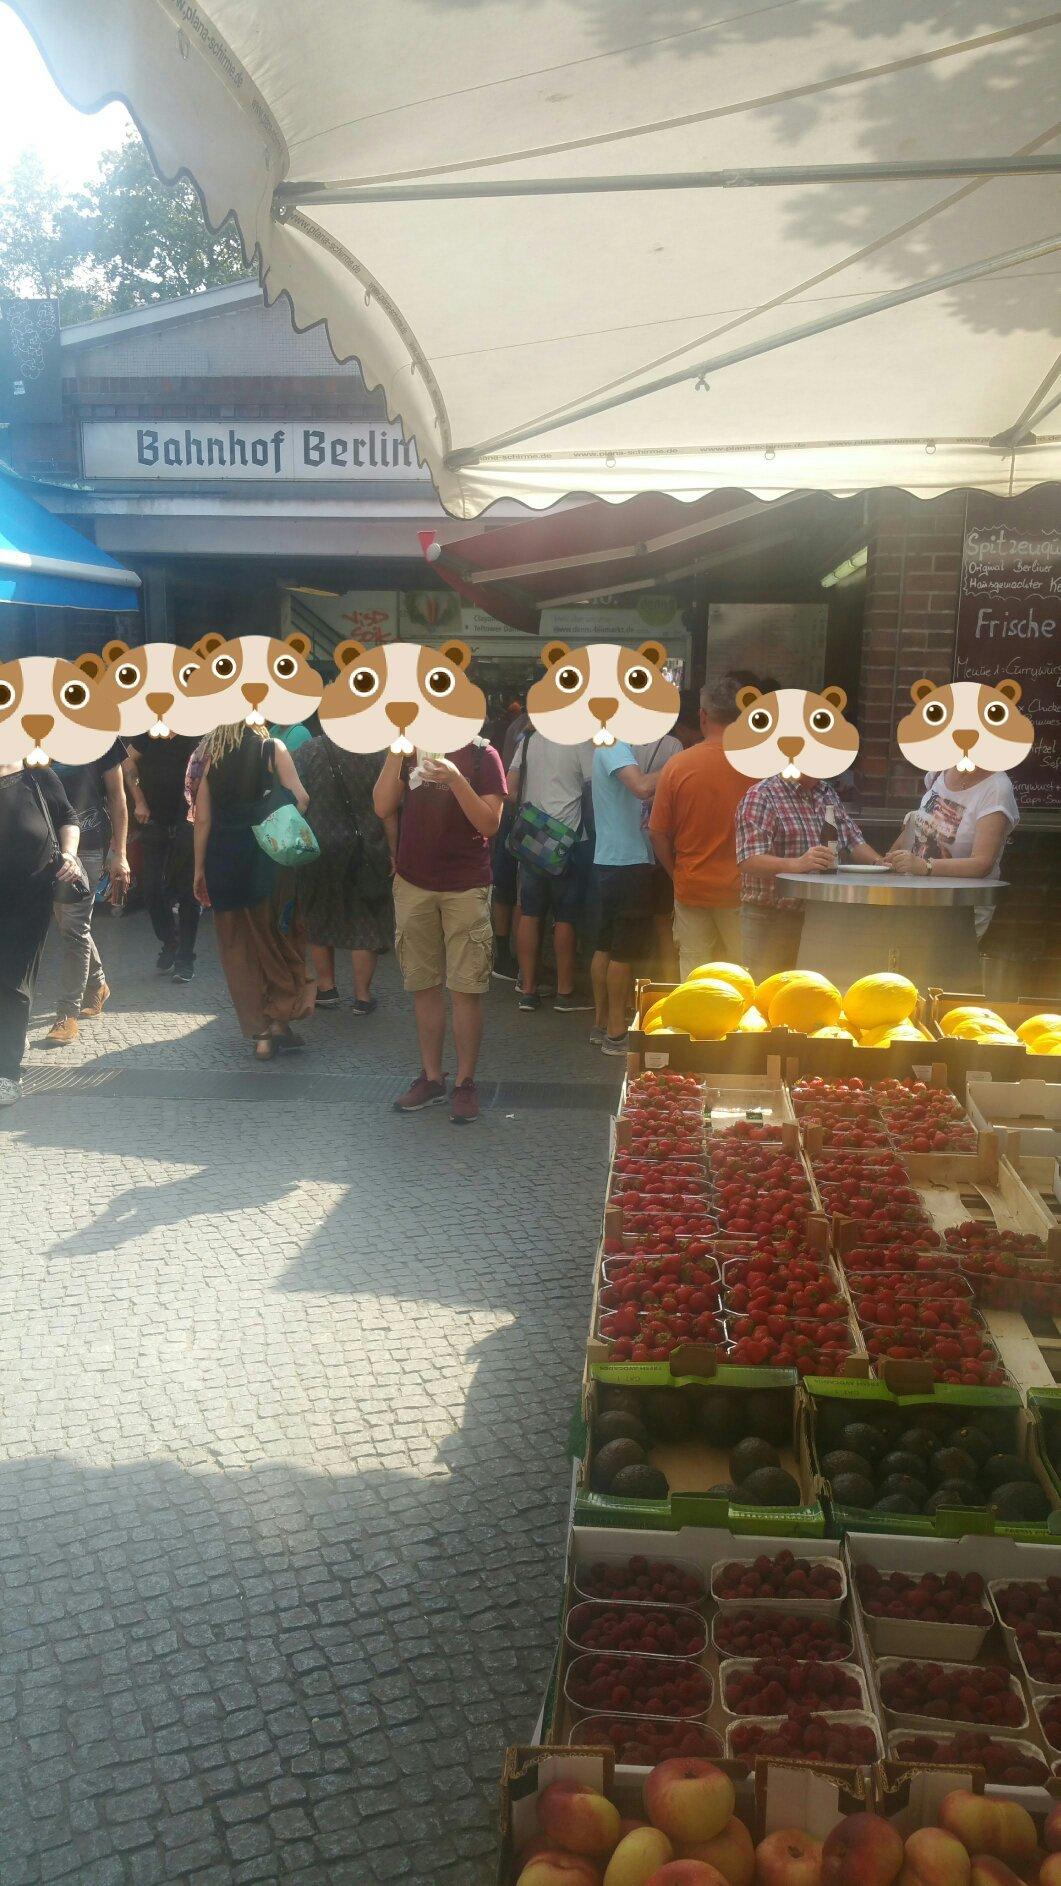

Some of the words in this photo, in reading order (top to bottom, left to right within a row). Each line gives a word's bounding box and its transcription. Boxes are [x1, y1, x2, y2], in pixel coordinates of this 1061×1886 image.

[171, 0, 243, 88] w.plana-schirme.de
[137, 429, 285, 474] Bahnhof
[303, 429, 412, 468] Berlin
[573, 448, 679, 458] www.plana-schirme.de
[968, 559, 1005, 577] Original
[1013, 559, 1053, 574] Berliner
[975, 607, 1056, 639] Frische
